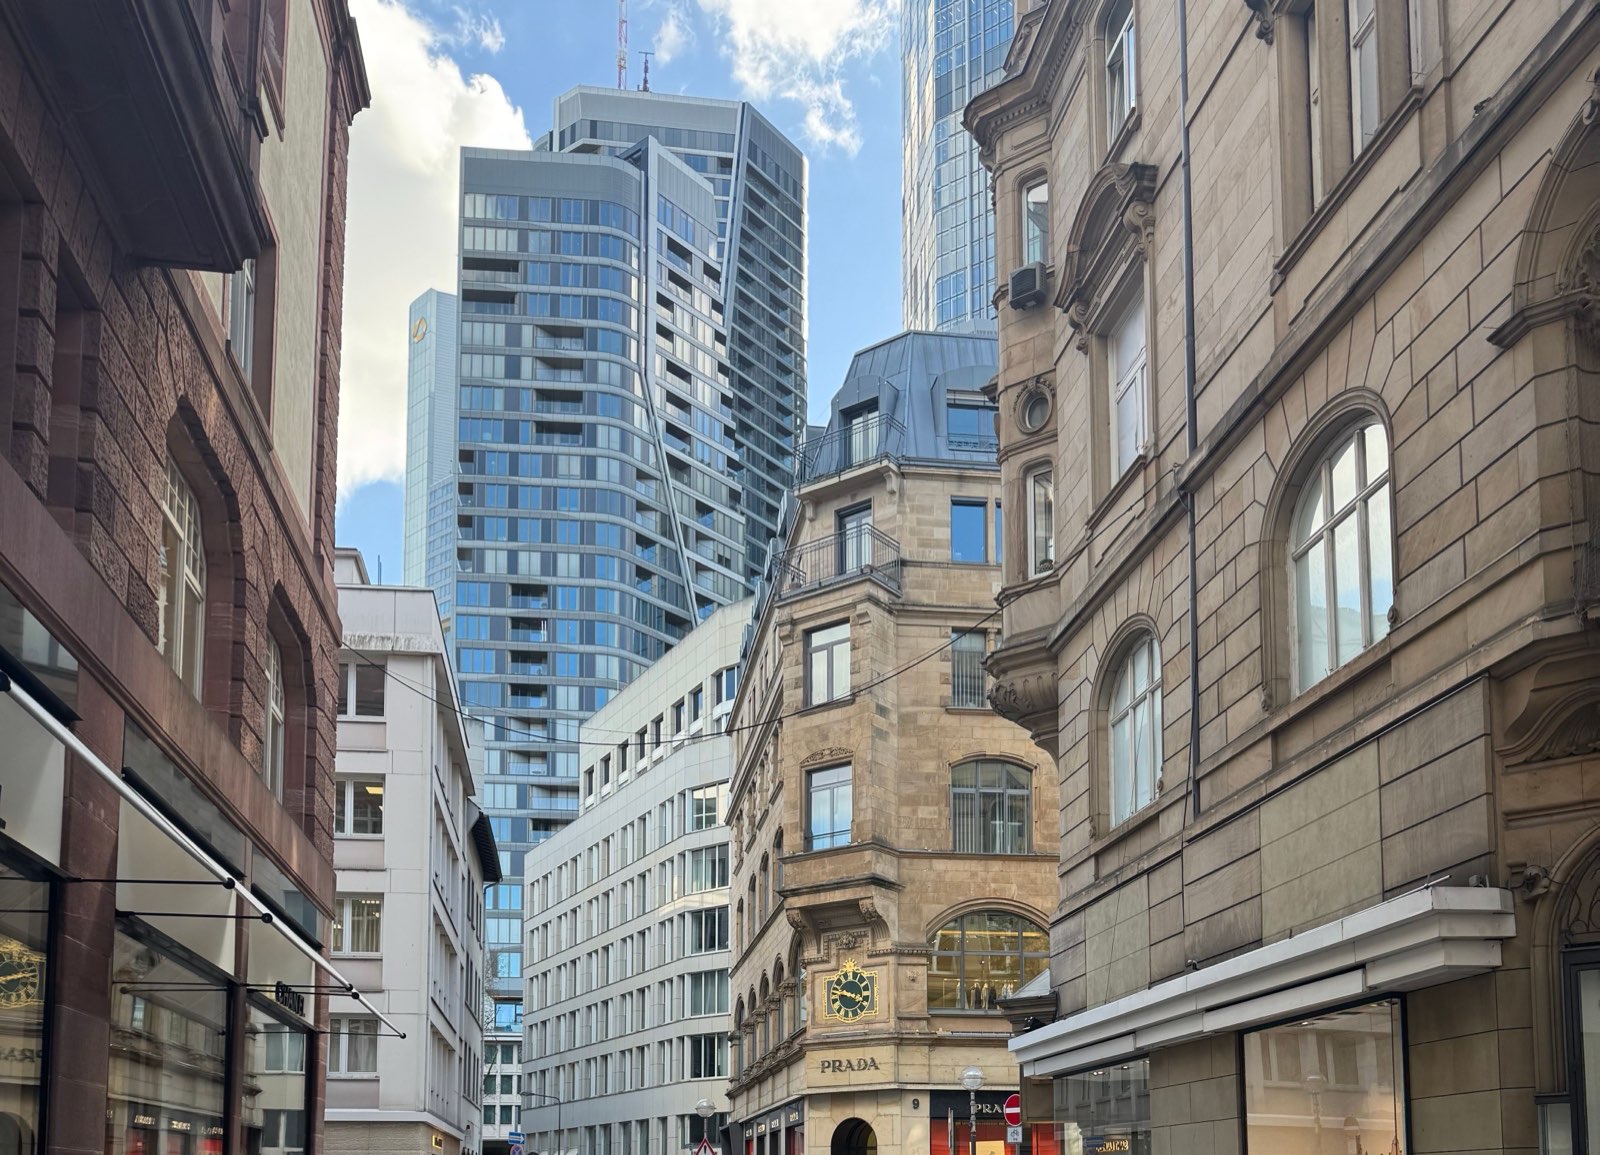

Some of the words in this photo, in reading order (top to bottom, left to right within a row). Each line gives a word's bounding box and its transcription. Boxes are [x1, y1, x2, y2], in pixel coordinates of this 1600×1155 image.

[820, 1056, 880, 1073] PRADA
[912, 1098, 920, 1110] 9
[975, 1103, 1005, 1114] PRA
